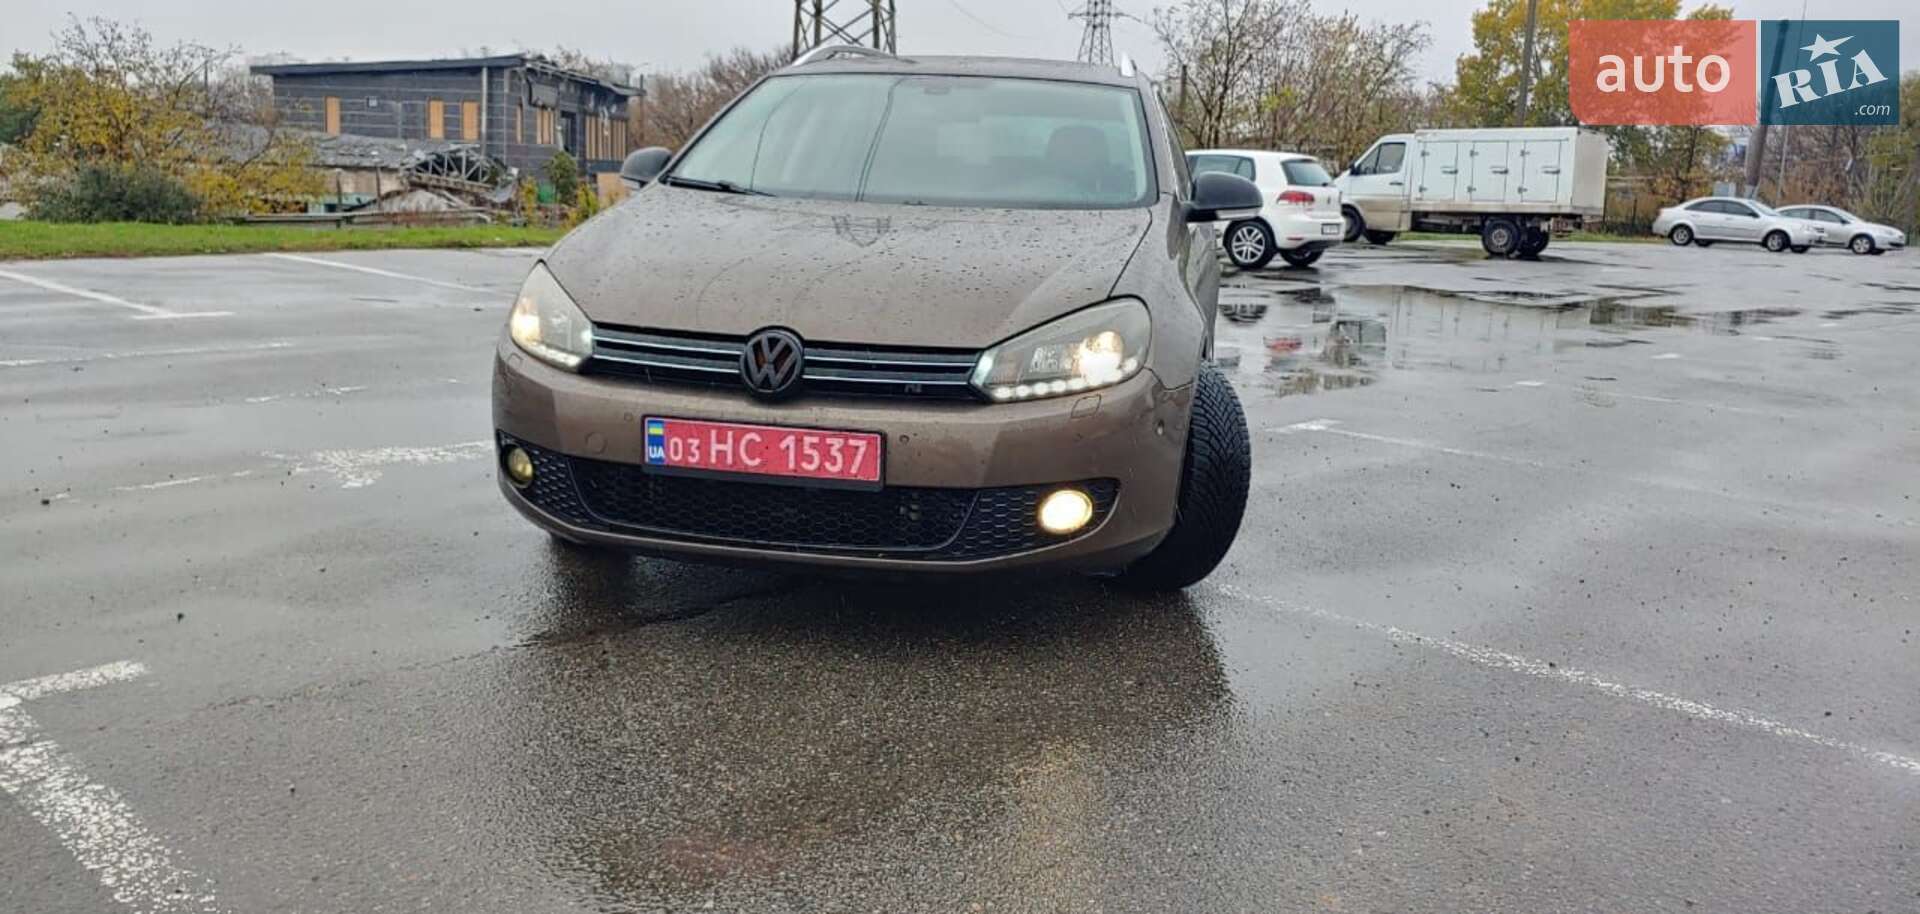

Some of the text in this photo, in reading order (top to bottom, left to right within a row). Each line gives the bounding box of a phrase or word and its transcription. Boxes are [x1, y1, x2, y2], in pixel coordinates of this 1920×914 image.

[748, 331, 796, 389] VW
[649, 446, 664, 458] UA
[669, 429, 867, 474] 03 HC 1537
